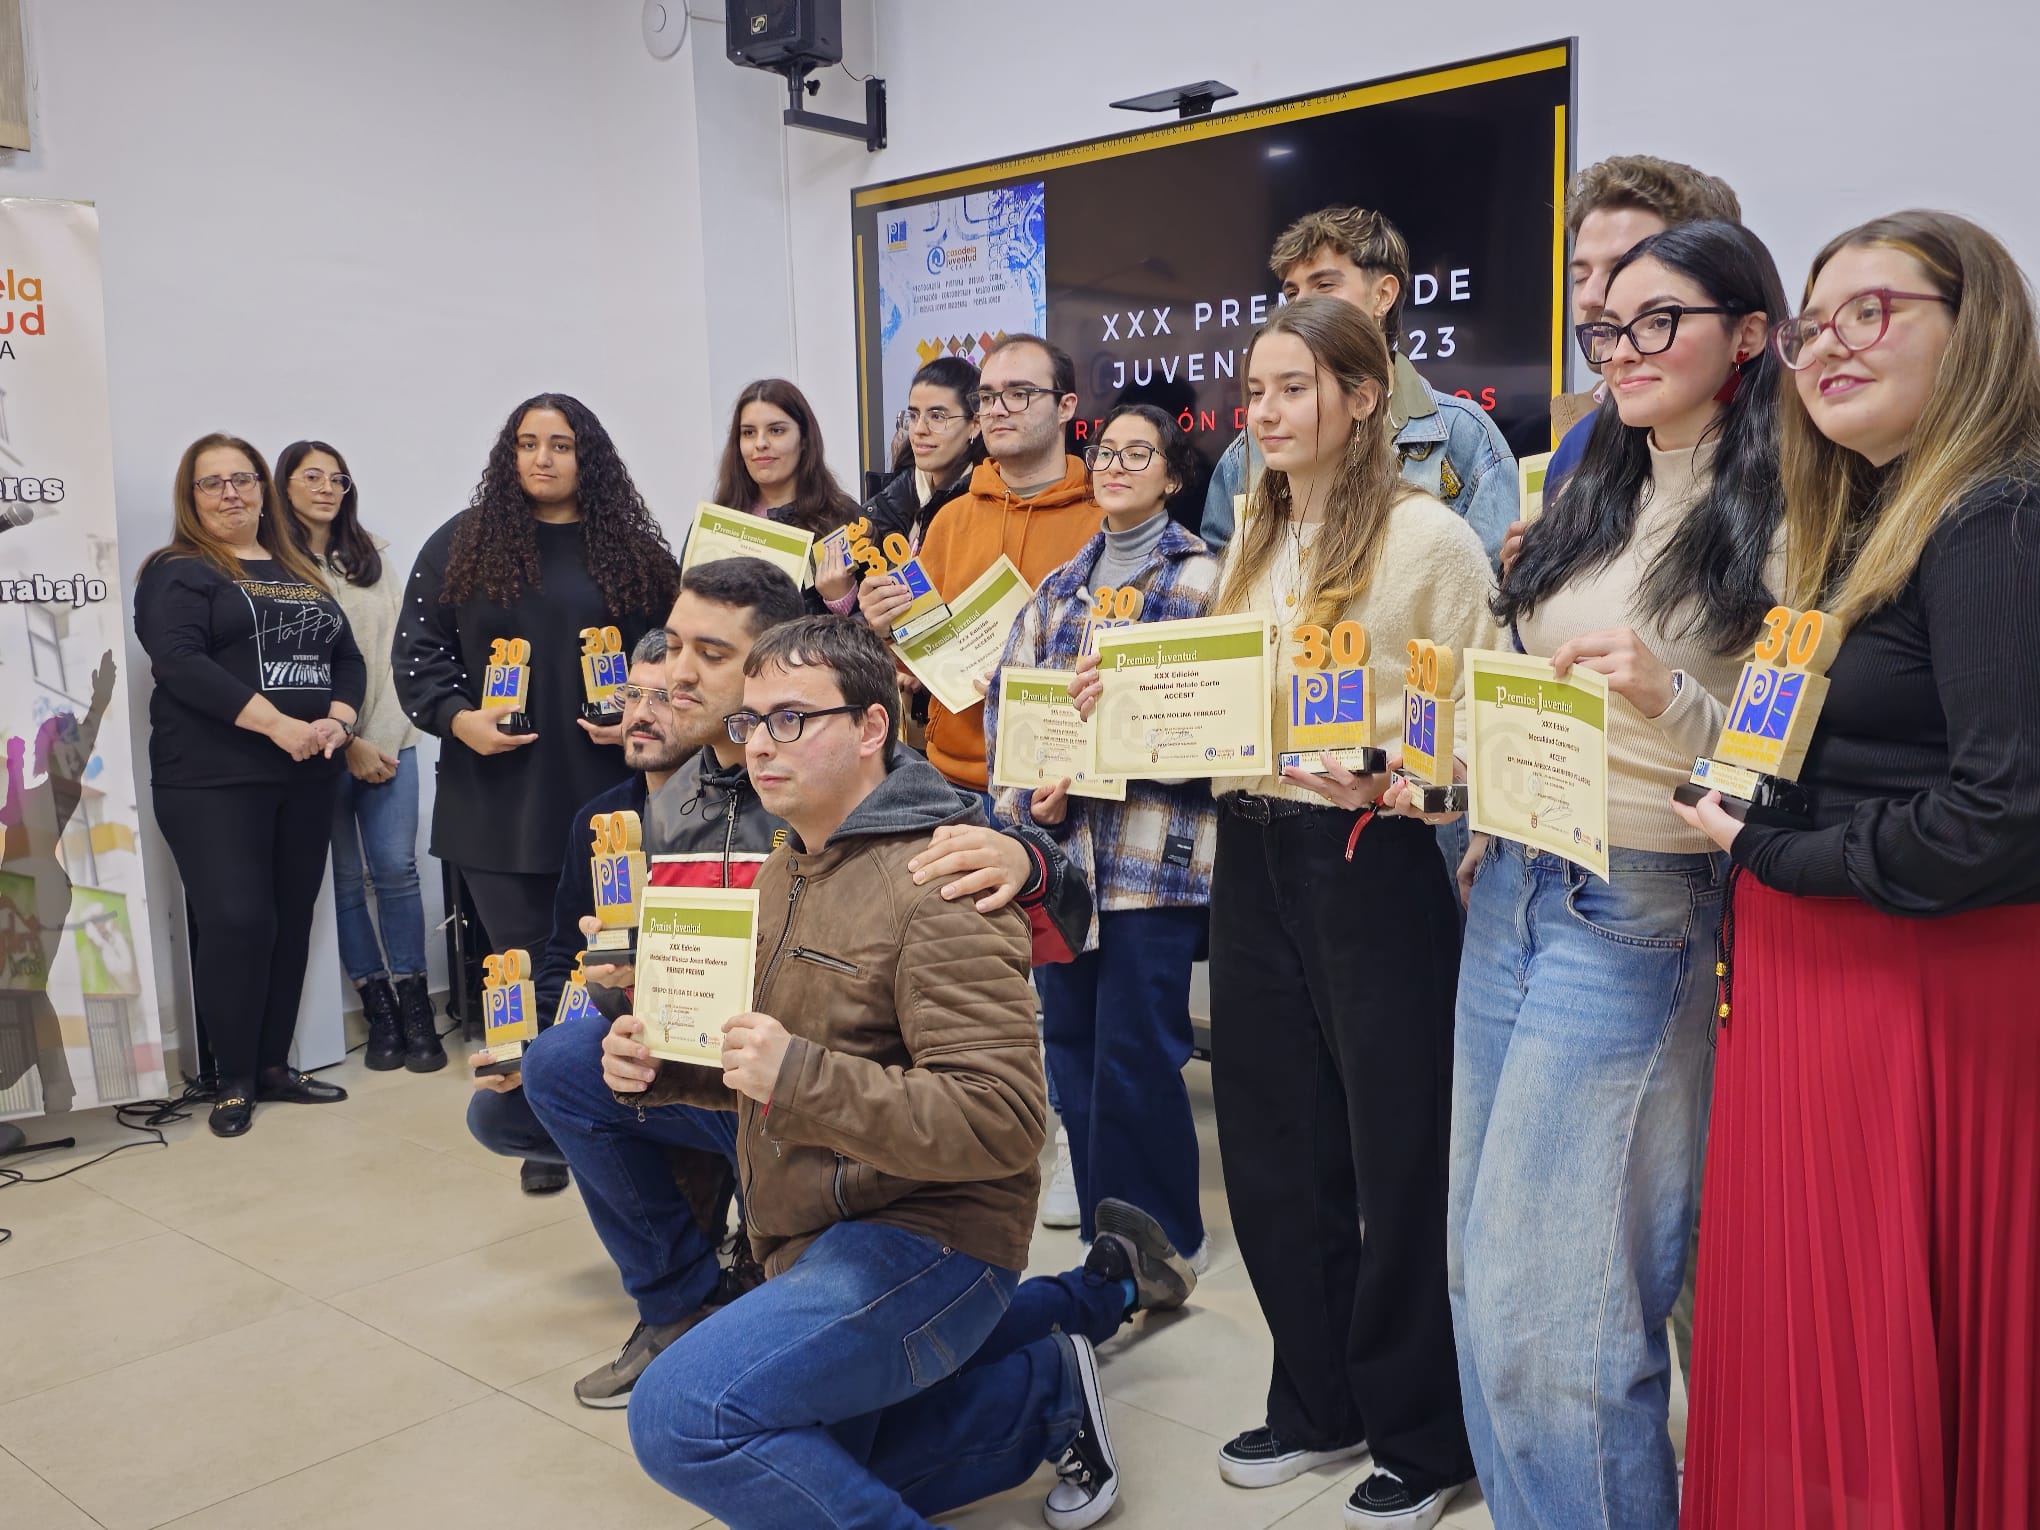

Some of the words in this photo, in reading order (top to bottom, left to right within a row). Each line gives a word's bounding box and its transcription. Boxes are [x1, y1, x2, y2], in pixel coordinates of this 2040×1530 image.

[0, 268, 43, 301] la
[1102, 307, 1173, 342] XXX
[1195, 292, 1289, 331] PRE
[1414, 268, 1471, 306] DE
[1112, 348, 1248, 389] JUVEN
[1393, 325, 1456, 361] 23
[0, 476, 65, 503] res
[0, 573, 107, 609] rabajo
[1091, 587, 1137, 618] 30
[489, 638, 525, 665] 30
[584, 626, 622, 655] 30
[1292, 620, 1365, 668] 30
[1754, 606, 1824, 665] 30
[1115, 653, 1155, 672] Premios
[1154, 672, 1170, 680] XXX
[1171, 670, 1199, 678] Edición
[1405, 639, 1438, 695] 30
[1139, 683, 1174, 692] Modalidad
[1176, 681, 1199, 689] Relato
[1200, 680, 1220, 688] Corto
[1495, 685, 1536, 708] Premios
[1142, 713, 1166, 721] BLANCA
[590, 811, 628, 853] 30
[482, 949, 520, 986] 30
